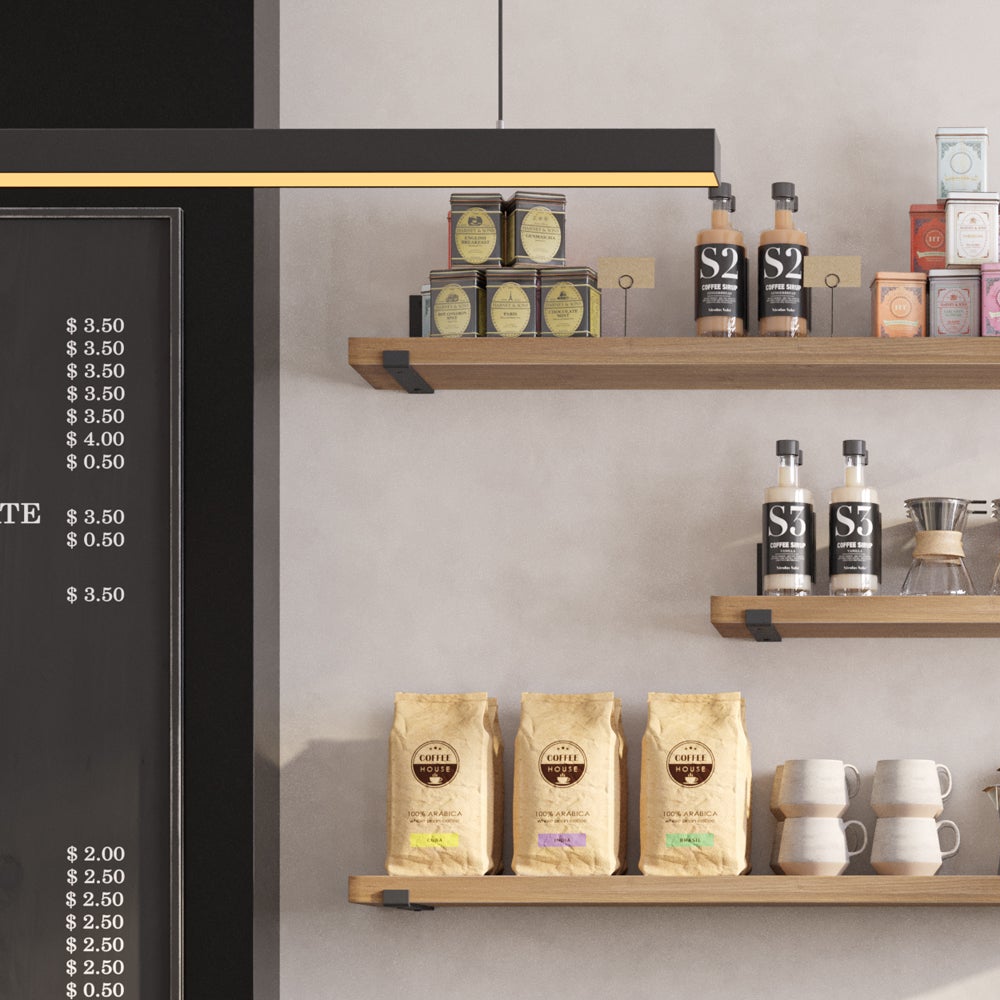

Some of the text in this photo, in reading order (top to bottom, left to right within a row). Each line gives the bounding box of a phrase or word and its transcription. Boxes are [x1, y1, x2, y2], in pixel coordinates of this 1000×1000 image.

[700, 247, 738, 279] S2
[764, 247, 802, 279] S2
[702, 283, 721, 291] COFFEE
[765, 283, 785, 291] COFFEE
[66, 317, 124, 335] $ 3.50
[67, 340, 124, 357] $ 3.50
[67, 363, 124, 380] $ 3.50
[67, 386, 125, 403] $ 3.50
[67, 408, 124, 425] $ 3.50
[67, 431, 124, 448] $ 4.00
[67, 454, 124, 471] $ 0.50
[0, 502, 41, 524] TE
[67, 509, 124, 526] $ 3.50
[768, 505, 806, 537] S3
[835, 505, 873, 537] S3
[67, 531, 124, 549] $ 0.50
[770, 541, 789, 549] COFFEE
[837, 541, 856, 549] COFFEE
[67, 587, 124, 604] $ 3.50
[419, 754, 450, 762] COFFEE
[546, 754, 578, 762] COFFEE
[674, 754, 706, 762] COFFEE
[420, 765, 451, 773] HOUSE
[547, 765, 578, 773] HOUSE
[675, 765, 706, 773] HOUSE
[67, 846, 125, 863] $ 2.00
[67, 868, 125, 886] $ 2.50
[66, 891, 123, 908] $ 2.50
[66, 914, 124, 931] $ 2.50
[66, 936, 124, 954] $ 2.50
[66, 959, 124, 977] $ 2.50
[66, 981, 124, 999] $ 0.50
